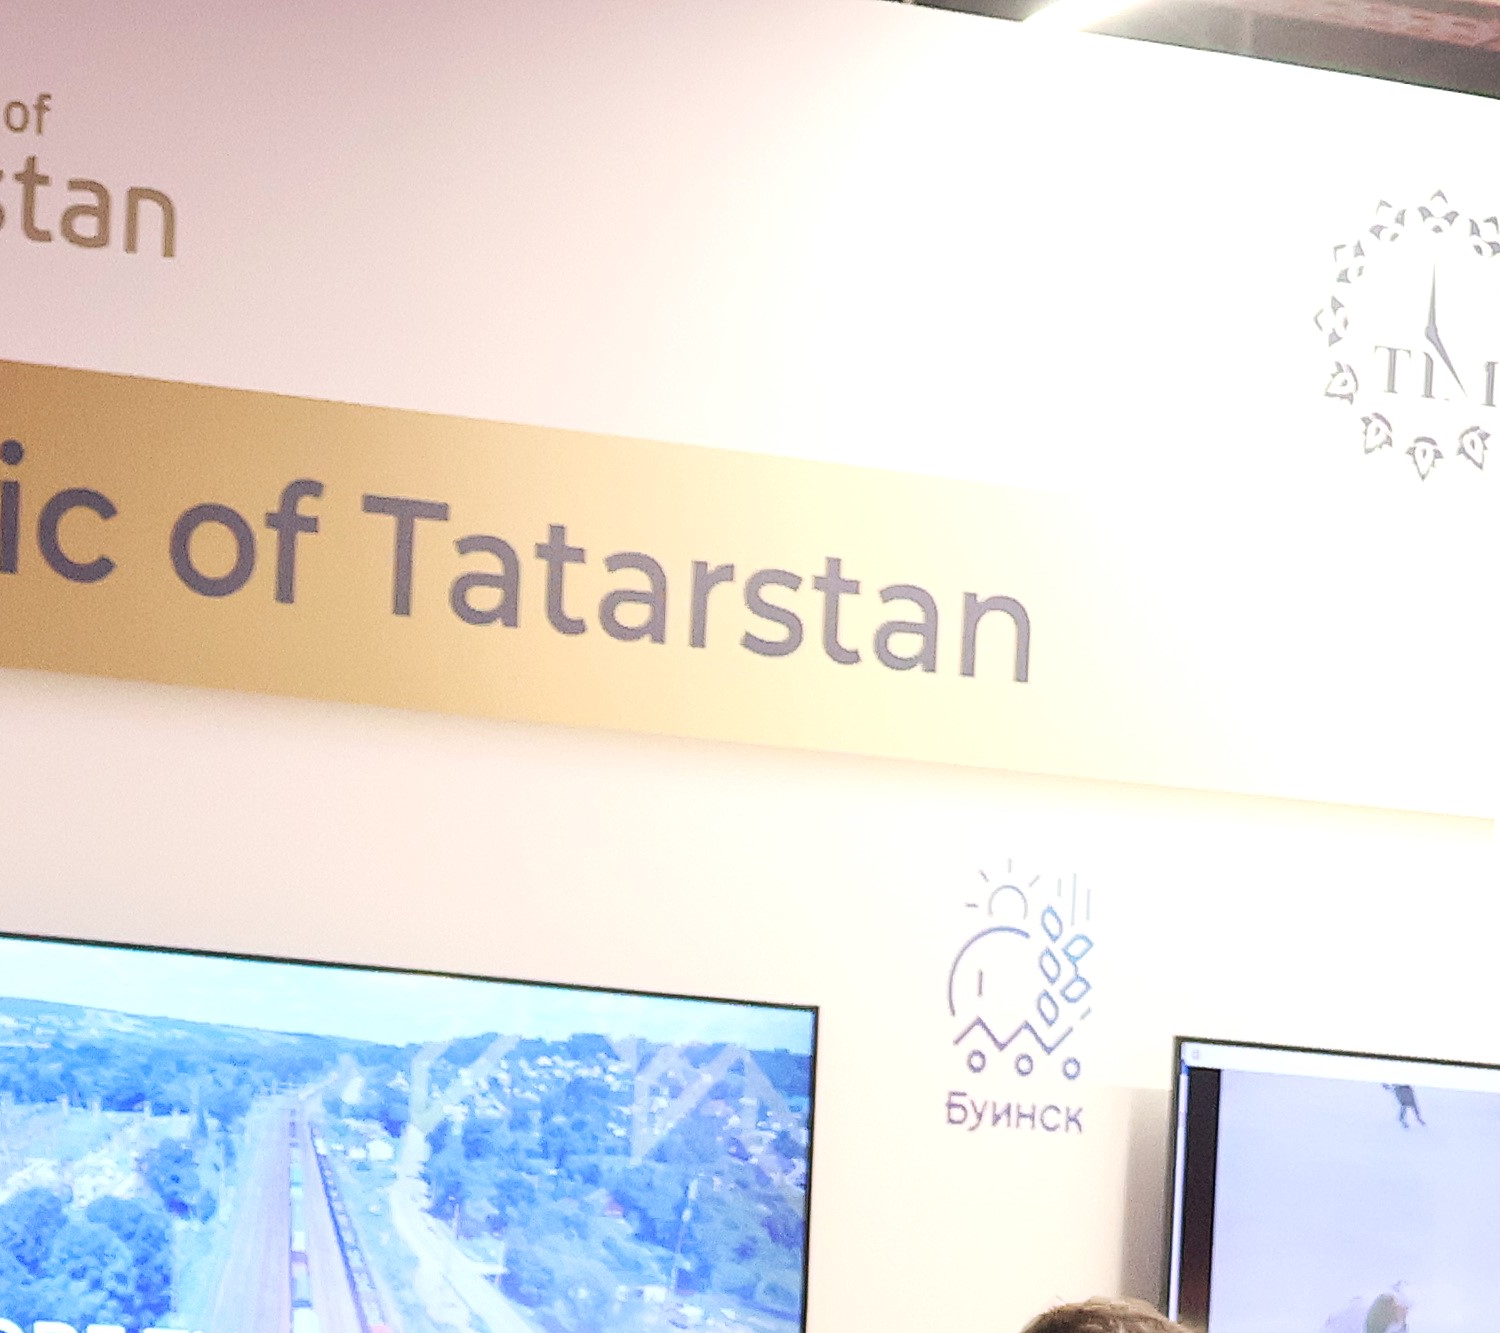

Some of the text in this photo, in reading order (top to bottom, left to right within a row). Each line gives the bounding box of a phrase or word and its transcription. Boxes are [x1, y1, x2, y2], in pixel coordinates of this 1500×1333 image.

[3, 92, 53, 135] of
[168, 478, 325, 605] of
[360, 492, 1031, 685] Tatarstan
